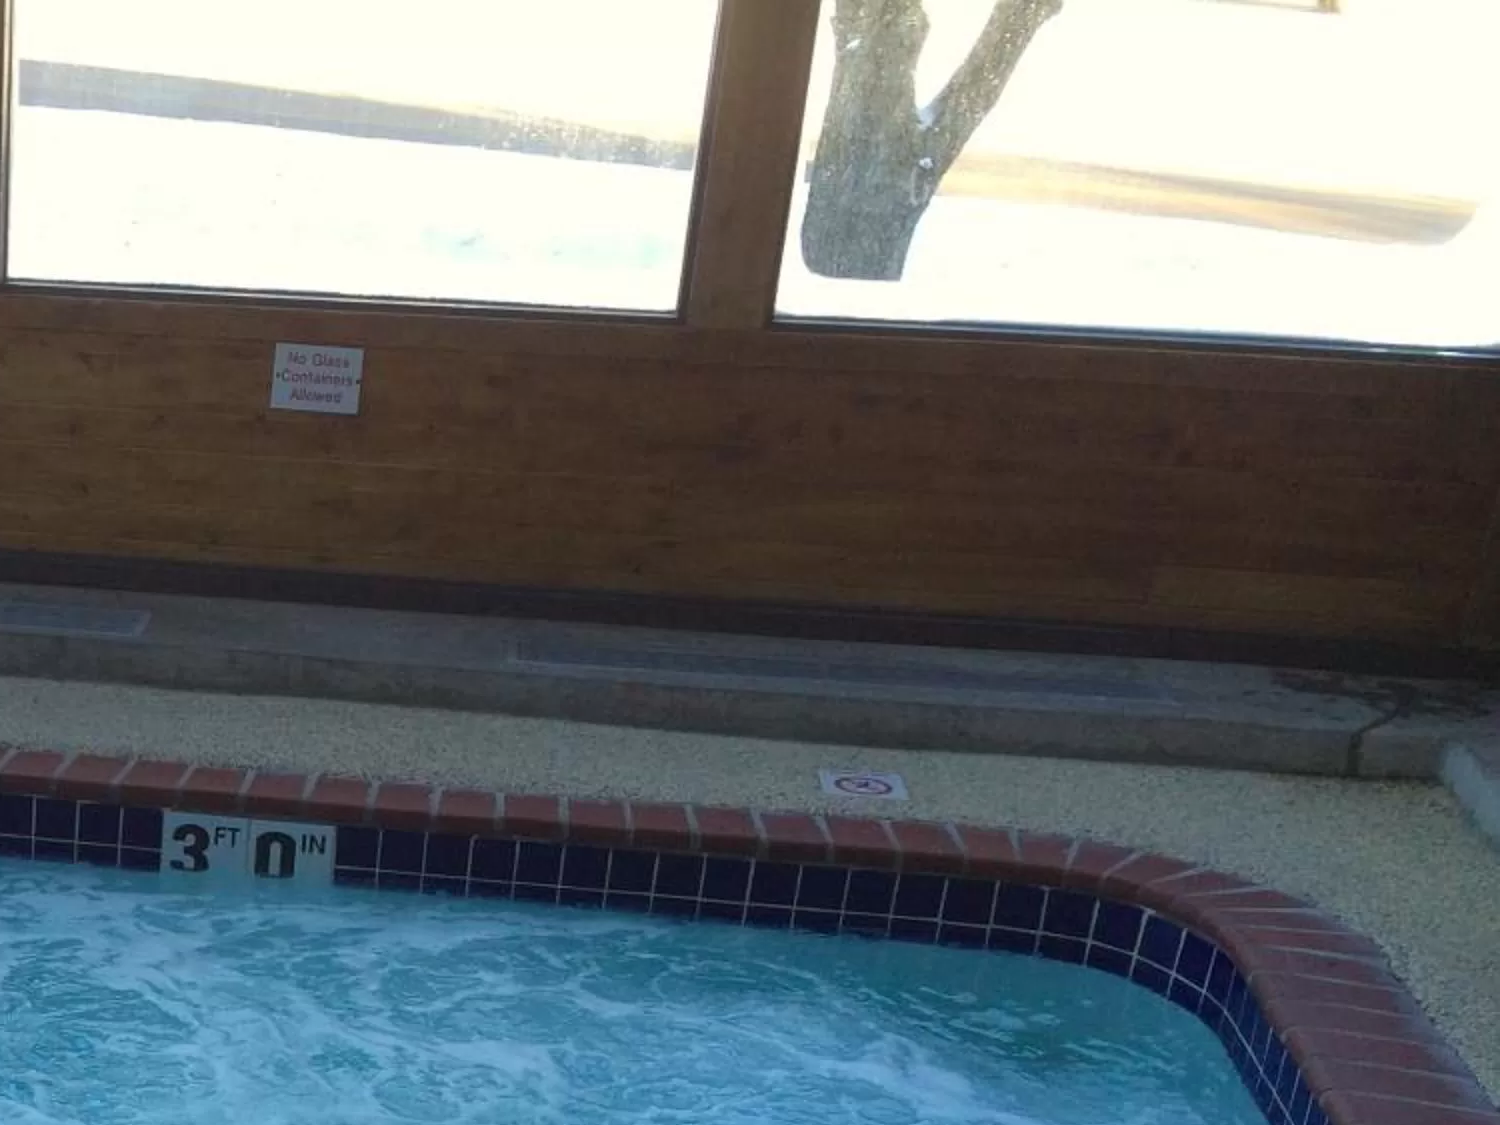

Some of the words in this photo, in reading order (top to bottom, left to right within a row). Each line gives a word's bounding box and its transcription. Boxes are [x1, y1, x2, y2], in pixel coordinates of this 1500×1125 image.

[287, 351, 307, 366] No
[311, 353, 351, 369] Glass
[281, 367, 353, 387] Containers
[289, 387, 343, 403] Allowed
[170, 824, 210, 871] 3
[214, 827, 240, 848] FT
[254, 831, 296, 878] 0
[301, 834, 327, 854] IN
